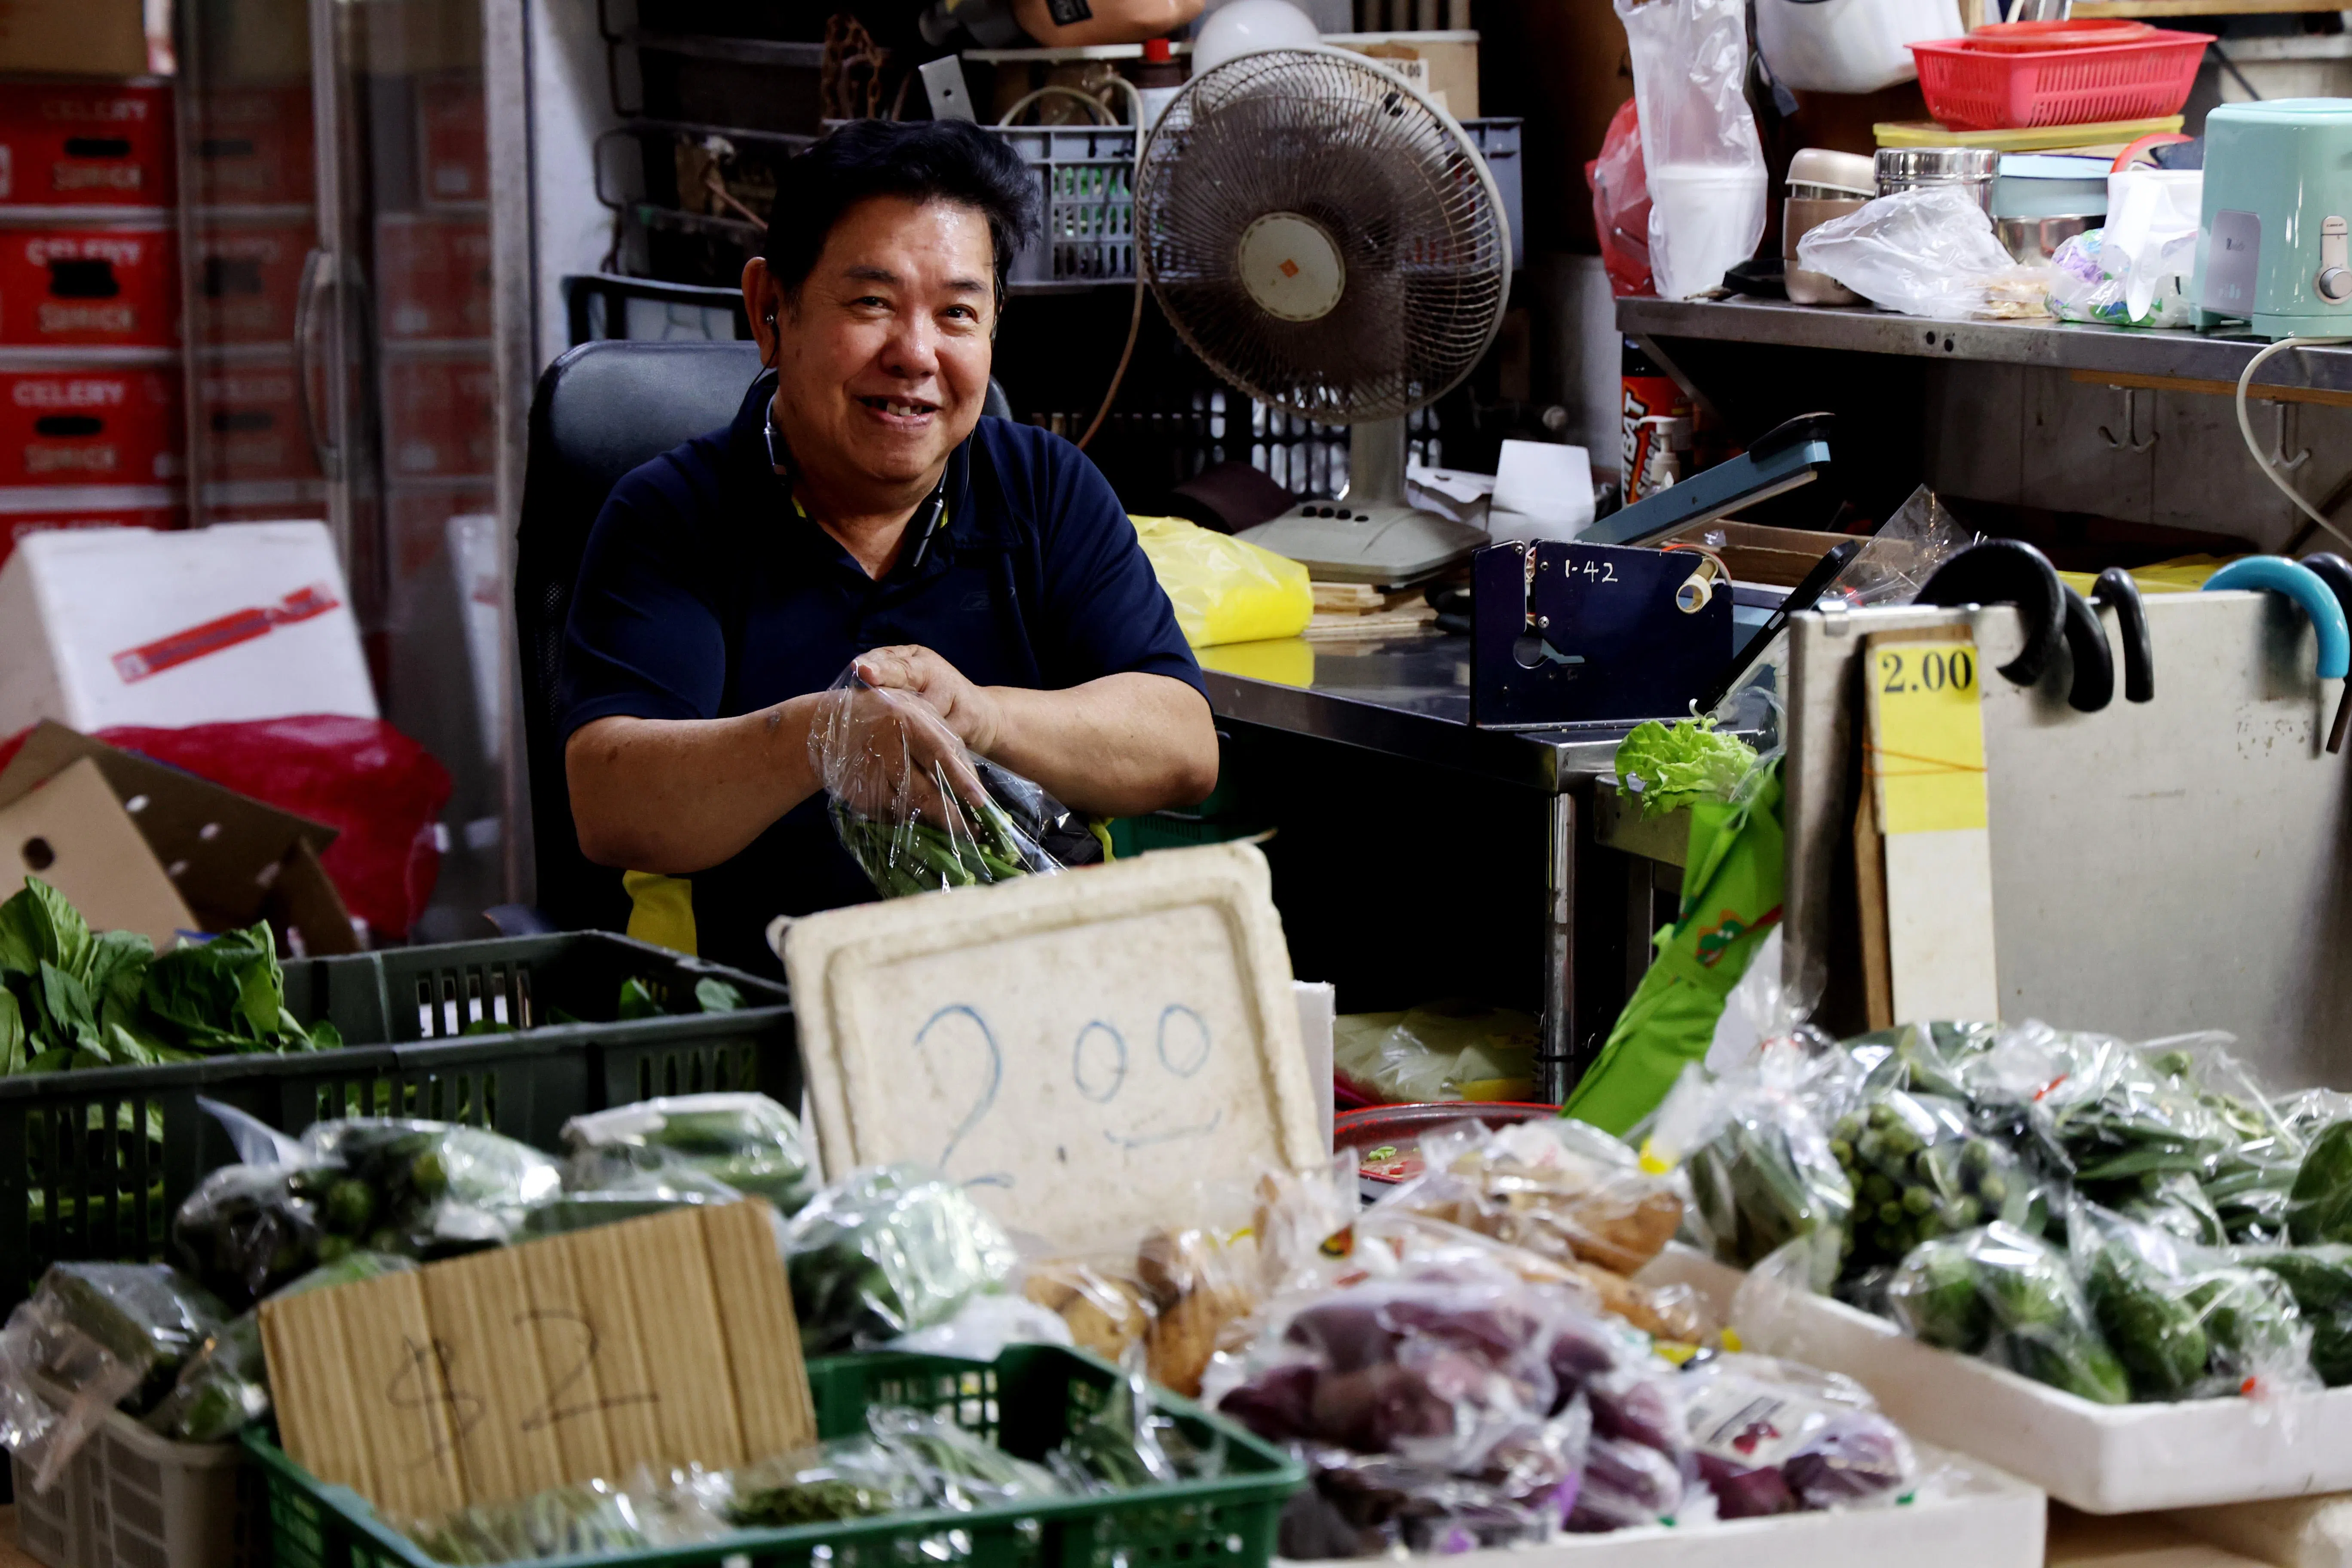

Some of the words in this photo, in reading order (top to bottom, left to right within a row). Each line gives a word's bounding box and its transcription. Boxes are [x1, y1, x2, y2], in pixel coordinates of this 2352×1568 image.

[12, 380, 126, 407] CELERY
[1565, 559, 1618, 583] 1-42
[1883, 651, 1972, 693] 2.00
[912, 1002, 1211, 1190] 2.00
[386, 1309, 660, 1476] $2
